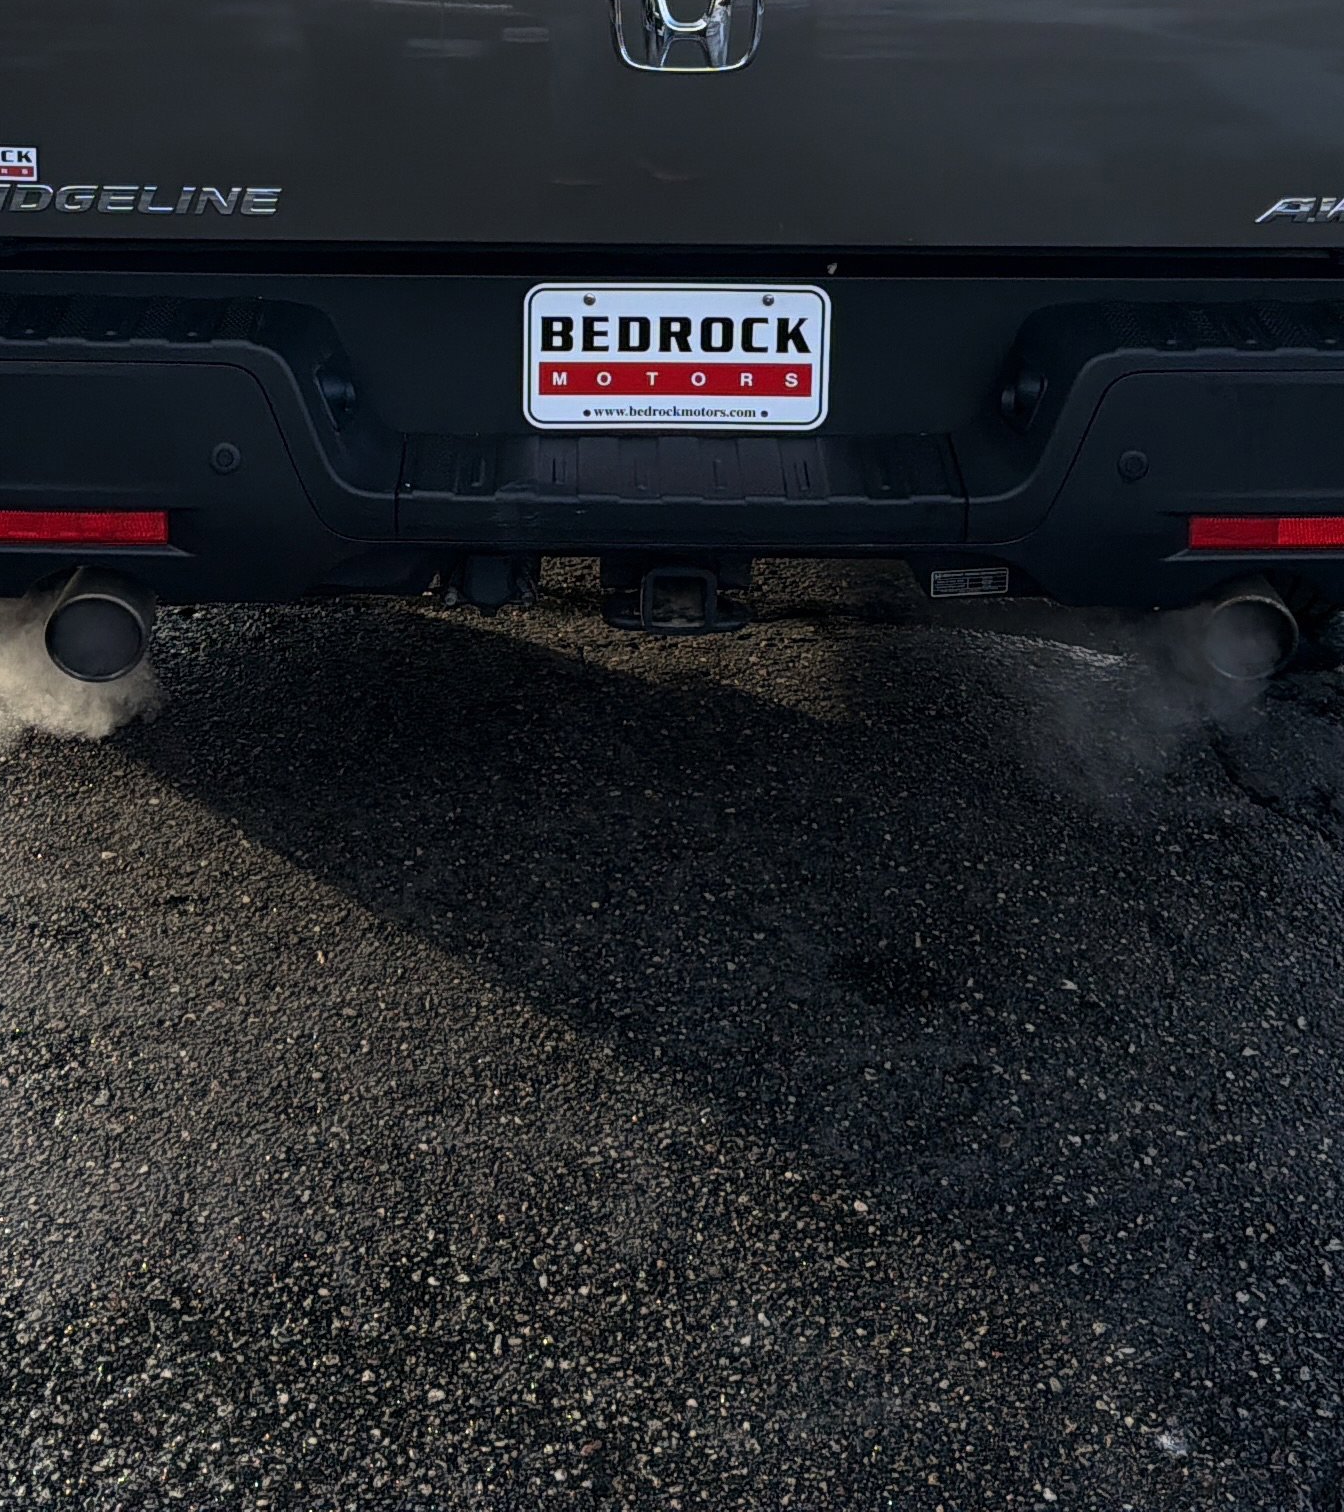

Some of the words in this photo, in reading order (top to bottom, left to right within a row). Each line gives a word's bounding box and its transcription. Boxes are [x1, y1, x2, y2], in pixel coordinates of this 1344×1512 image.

[540, 316, 812, 354] BEDROCK
[551, 370, 799, 388] MOTORS
[593, 405, 757, 419] www.bedrockmotors.com
